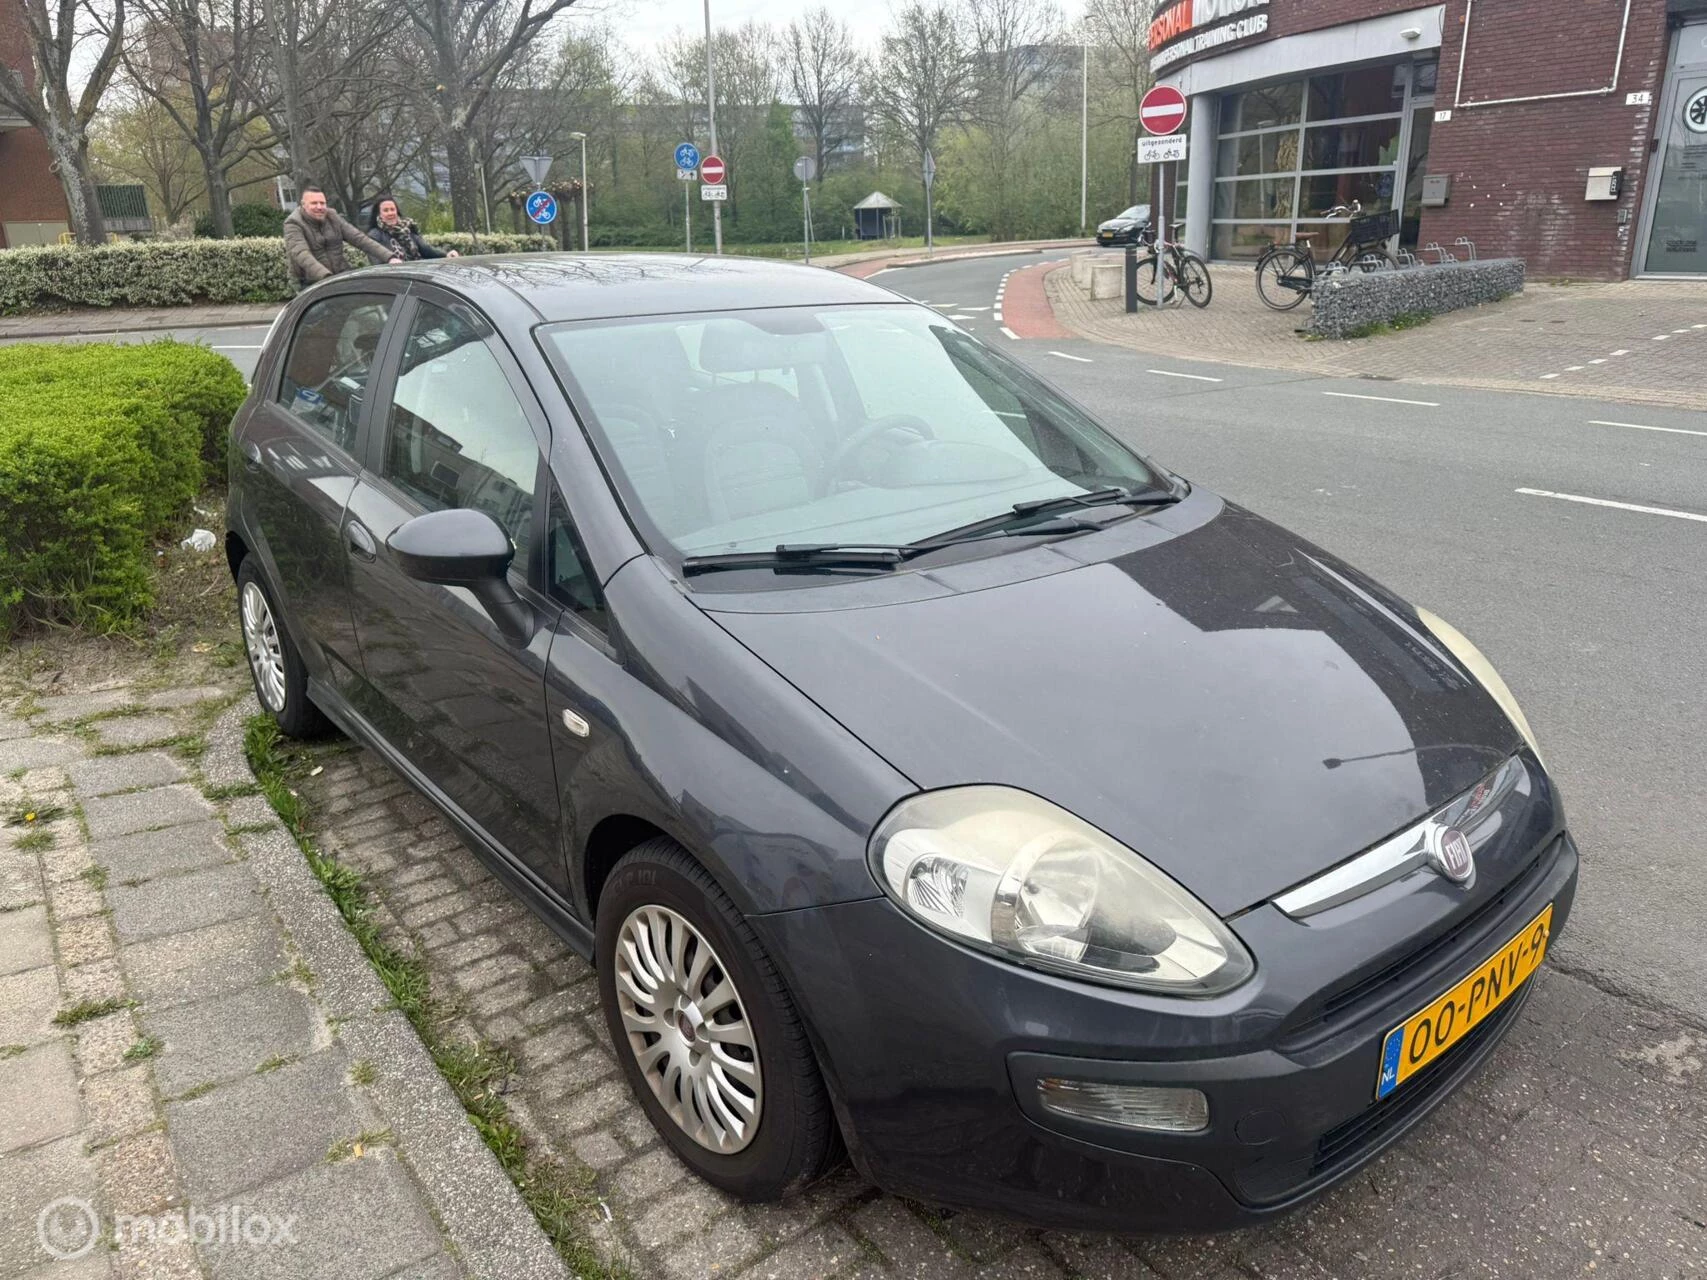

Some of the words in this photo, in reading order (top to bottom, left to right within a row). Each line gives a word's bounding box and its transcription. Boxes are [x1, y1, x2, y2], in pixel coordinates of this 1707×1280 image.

[1236, 14, 1268, 39] CLUB
[1632, 94, 1643, 103] 34
[1445, 836, 1468, 870] FIAT
[1409, 922, 1545, 1064] 00-PNV-9
[1381, 1068, 1395, 1086] NL
